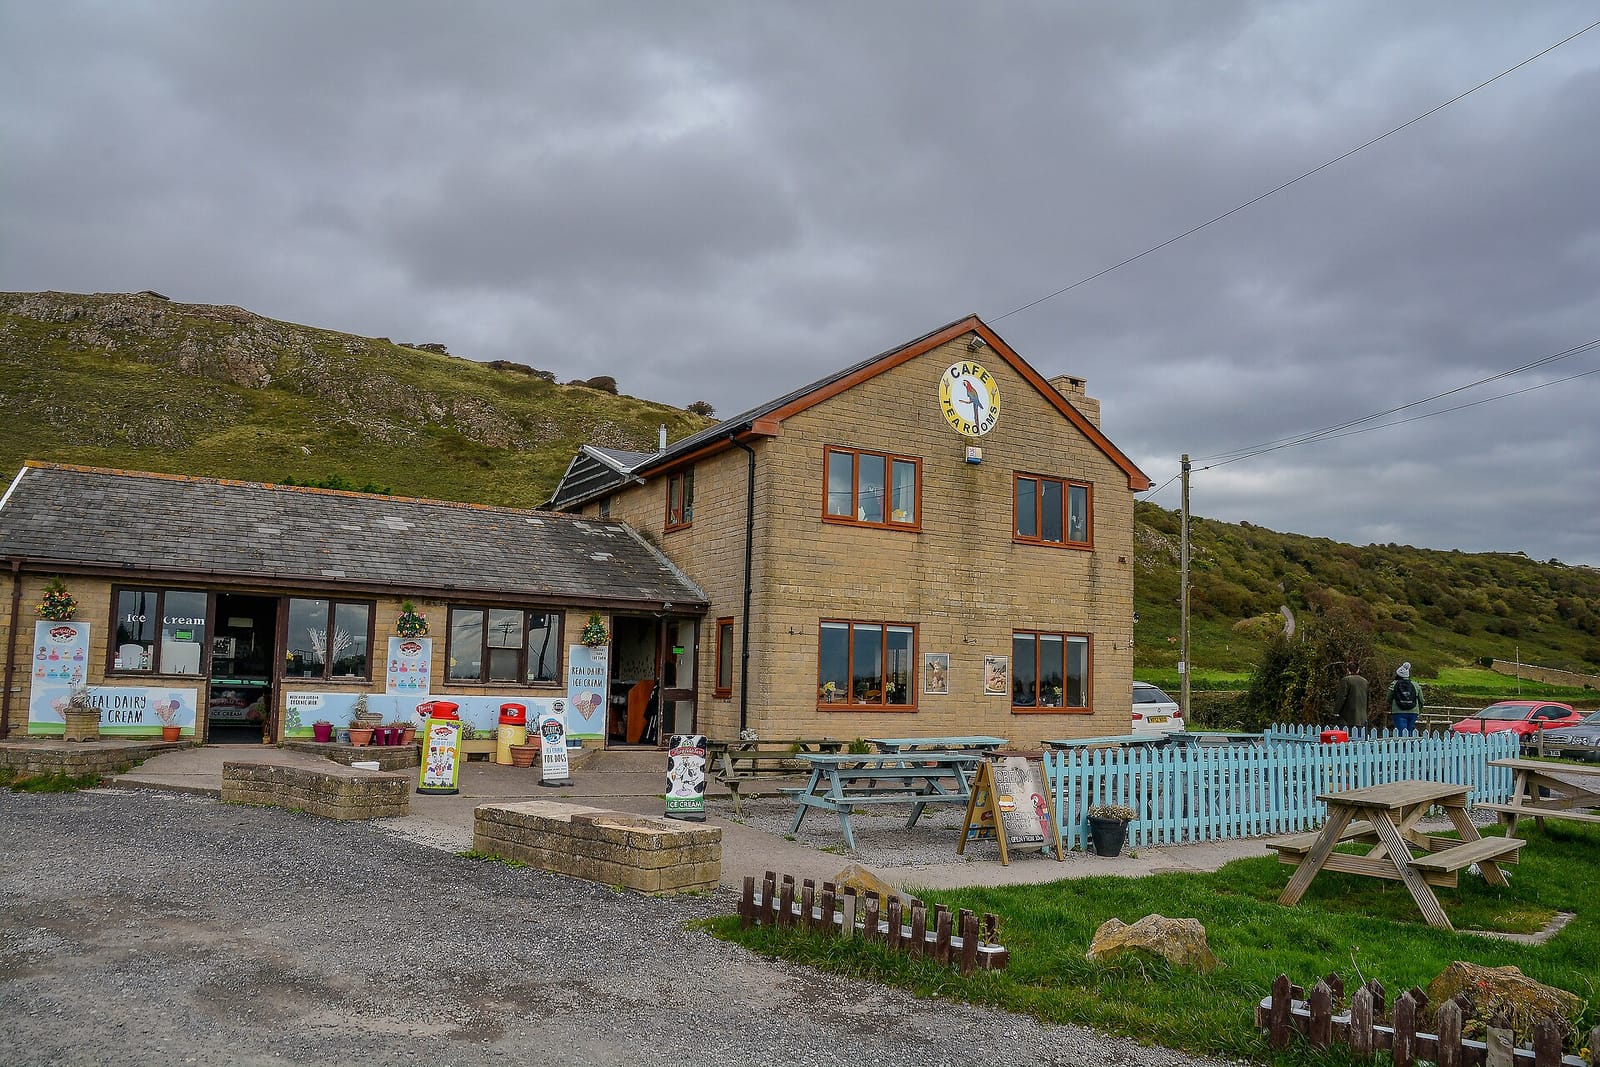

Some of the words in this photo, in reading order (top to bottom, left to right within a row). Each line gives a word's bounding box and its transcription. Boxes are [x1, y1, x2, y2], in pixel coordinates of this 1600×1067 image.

[950, 363, 990, 384] CAFE
[126, 613, 147, 623] Ice
[163, 615, 205, 625] Cream
[571, 666, 585, 675] REAL
[586, 667, 604, 676] DAIRY
[572, 678, 582, 687] ICE
[583, 678, 603, 688] CREAM
[85, 695, 110, 709] REAL
[114, 695, 147, 709] DAIRY
[108, 709, 144, 724] CREAM
[544, 754, 554, 763] FOR
[554, 754, 567, 763] DOGS
